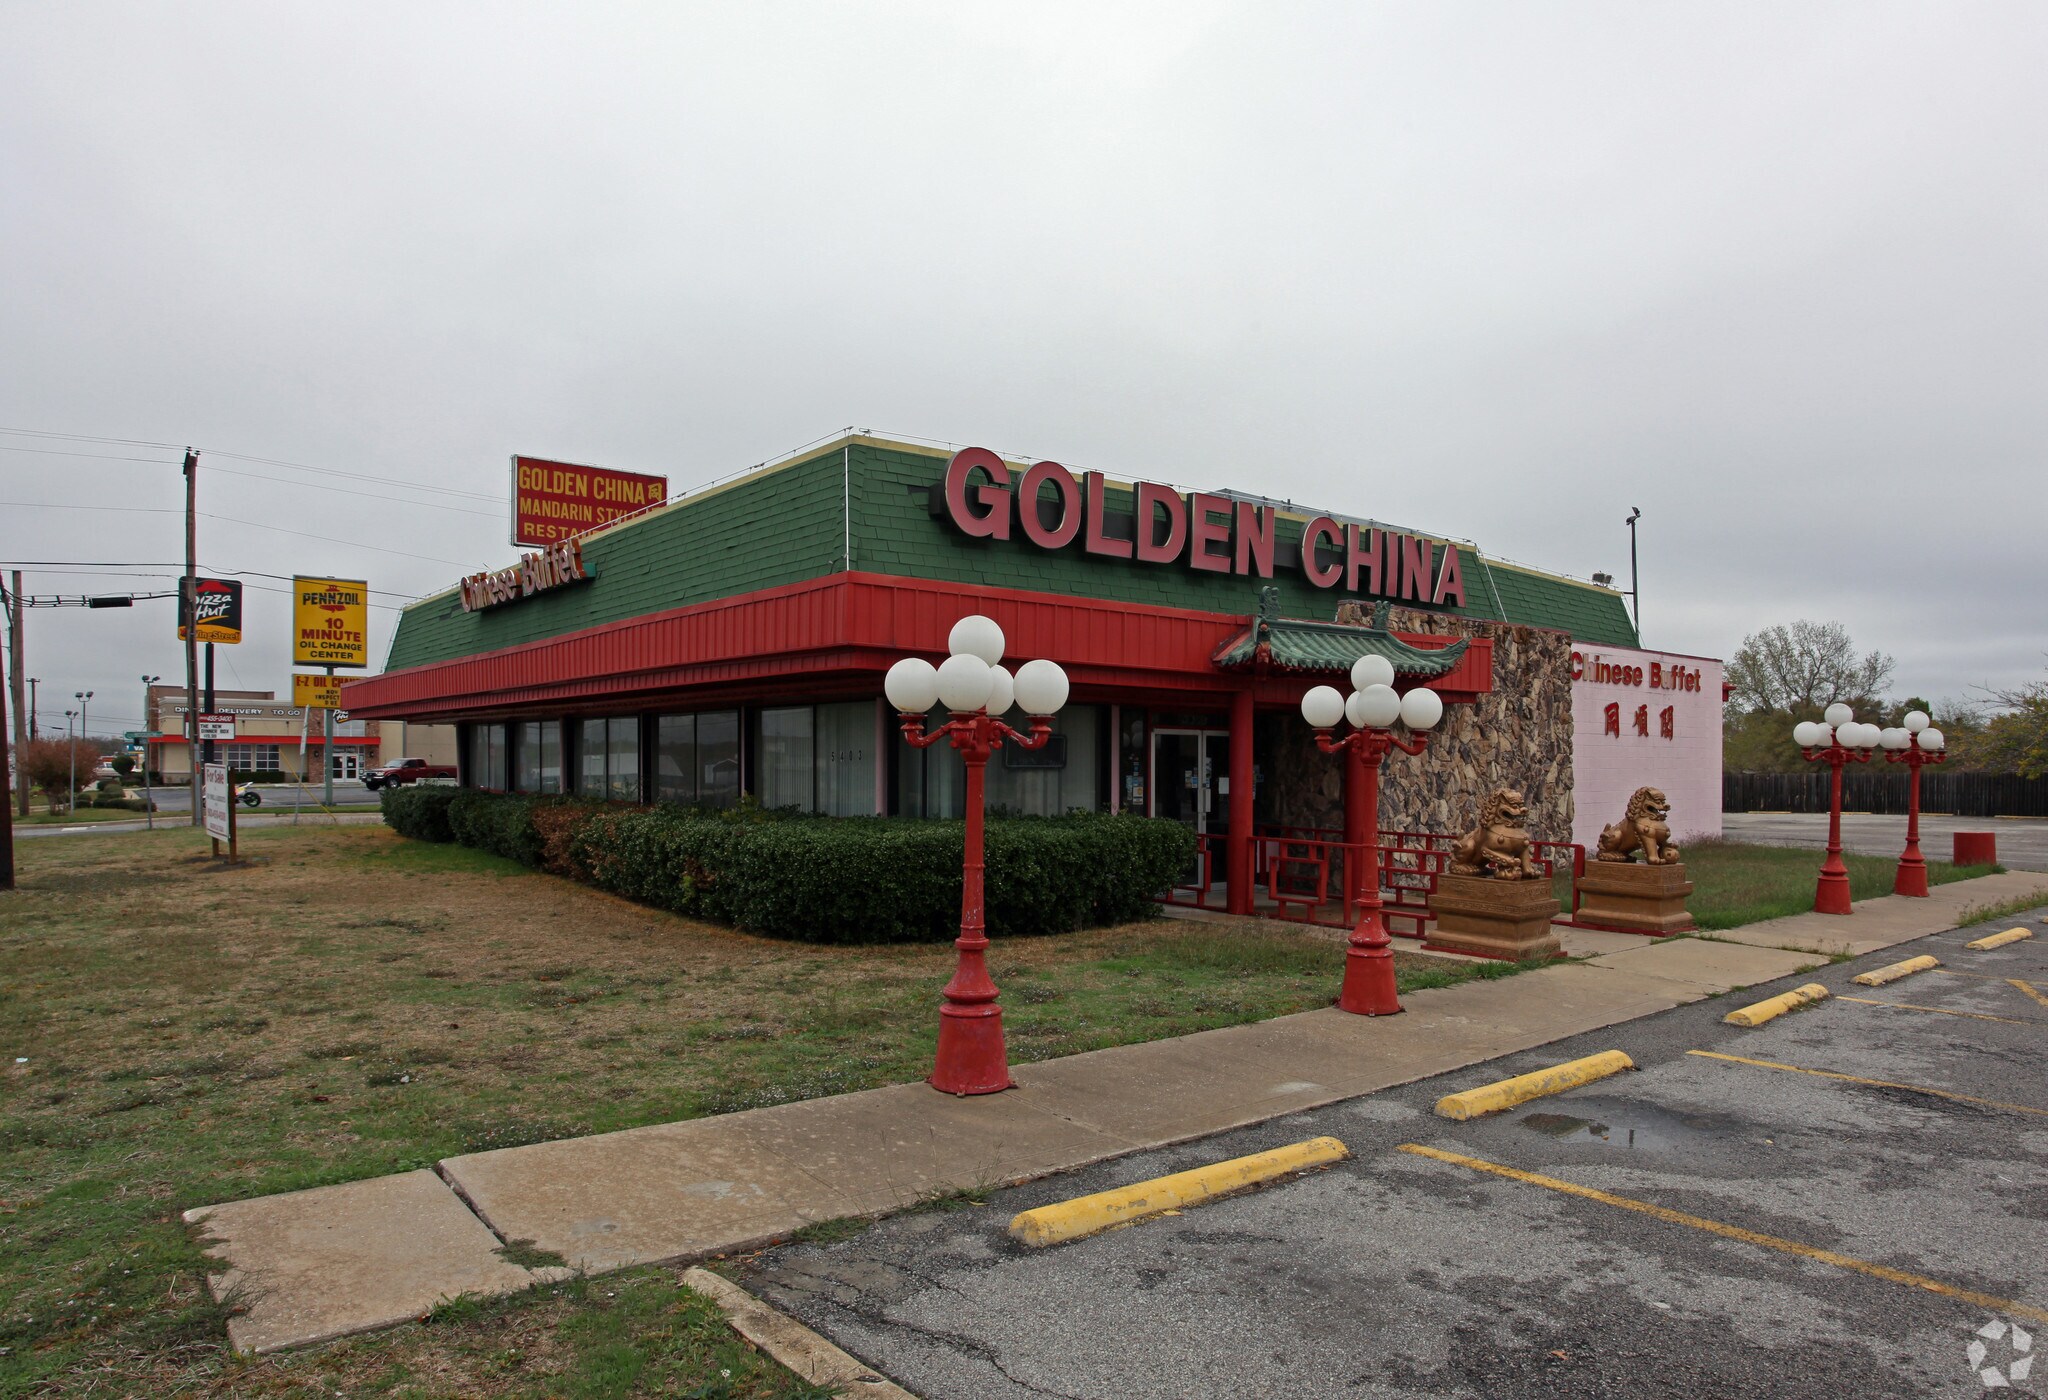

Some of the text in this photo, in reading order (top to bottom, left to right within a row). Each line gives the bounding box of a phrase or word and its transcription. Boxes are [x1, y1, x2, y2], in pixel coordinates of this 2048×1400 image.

[519, 466, 646, 504] GOLDEN CHINA
[520, 497, 593, 523] MANDARIN
[944, 447, 1467, 608] GOLDEN CHINA
[460, 539, 583, 613] Chinese Buffet
[302, 592, 360, 606] PENNZOIL
[196, 604, 231, 620] Hut
[325, 618, 344, 630] 10
[301, 629, 362, 642] MINUTE
[299, 641, 363, 651] OIL CHANGE
[310, 651, 354, 660] CENTER
[1570, 651, 1702, 692] Chinese Buffet
[296, 676, 310, 687] E-Z
[313, 677, 327, 688] OIL
[218, 707, 263, 715] DELIVERY
